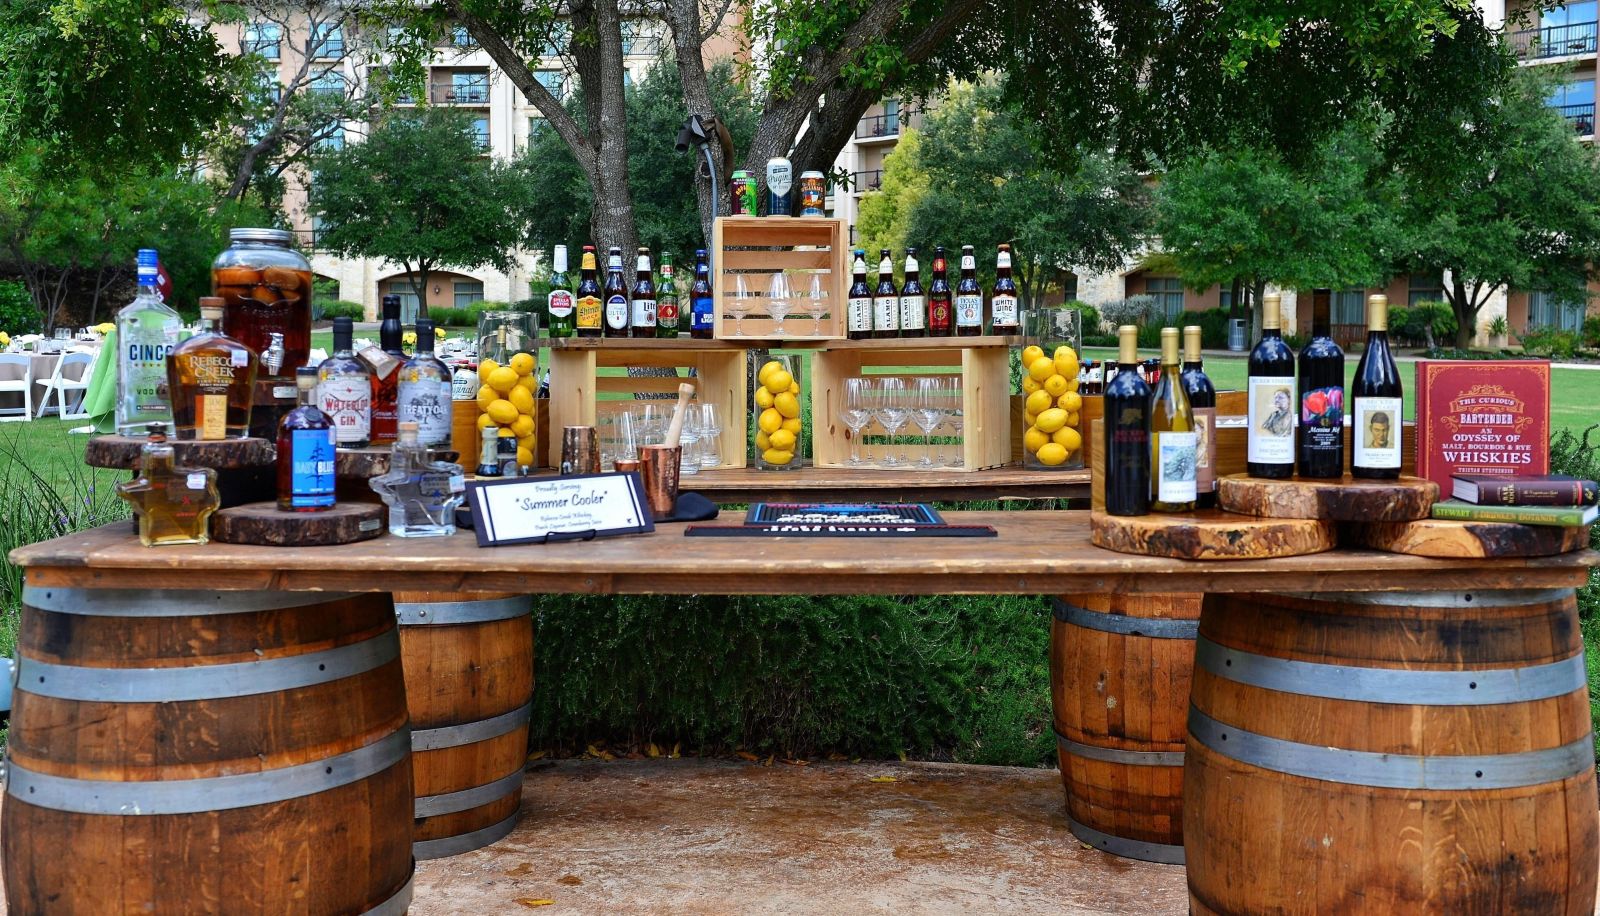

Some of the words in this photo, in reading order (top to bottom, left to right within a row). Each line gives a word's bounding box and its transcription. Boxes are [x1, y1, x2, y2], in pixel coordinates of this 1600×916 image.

[643, 302, 656, 312] Lite
[194, 366, 235, 379] CREEK
[1478, 397, 1515, 406] CURIOUS
[403, 404, 433, 415] TREATY
[340, 416, 356, 426] GIN
[1460, 413, 1513, 424] BARTENDER
[1453, 434, 1502, 442] ODYSSEY
[1505, 434, 1521, 442] OF
[1442, 451, 1531, 464] WHISKIES
[317, 461, 335, 474] BLUE
[1435, 508, 1471, 517] STEWART
[1519, 513, 1558, 522] BOTANIST
